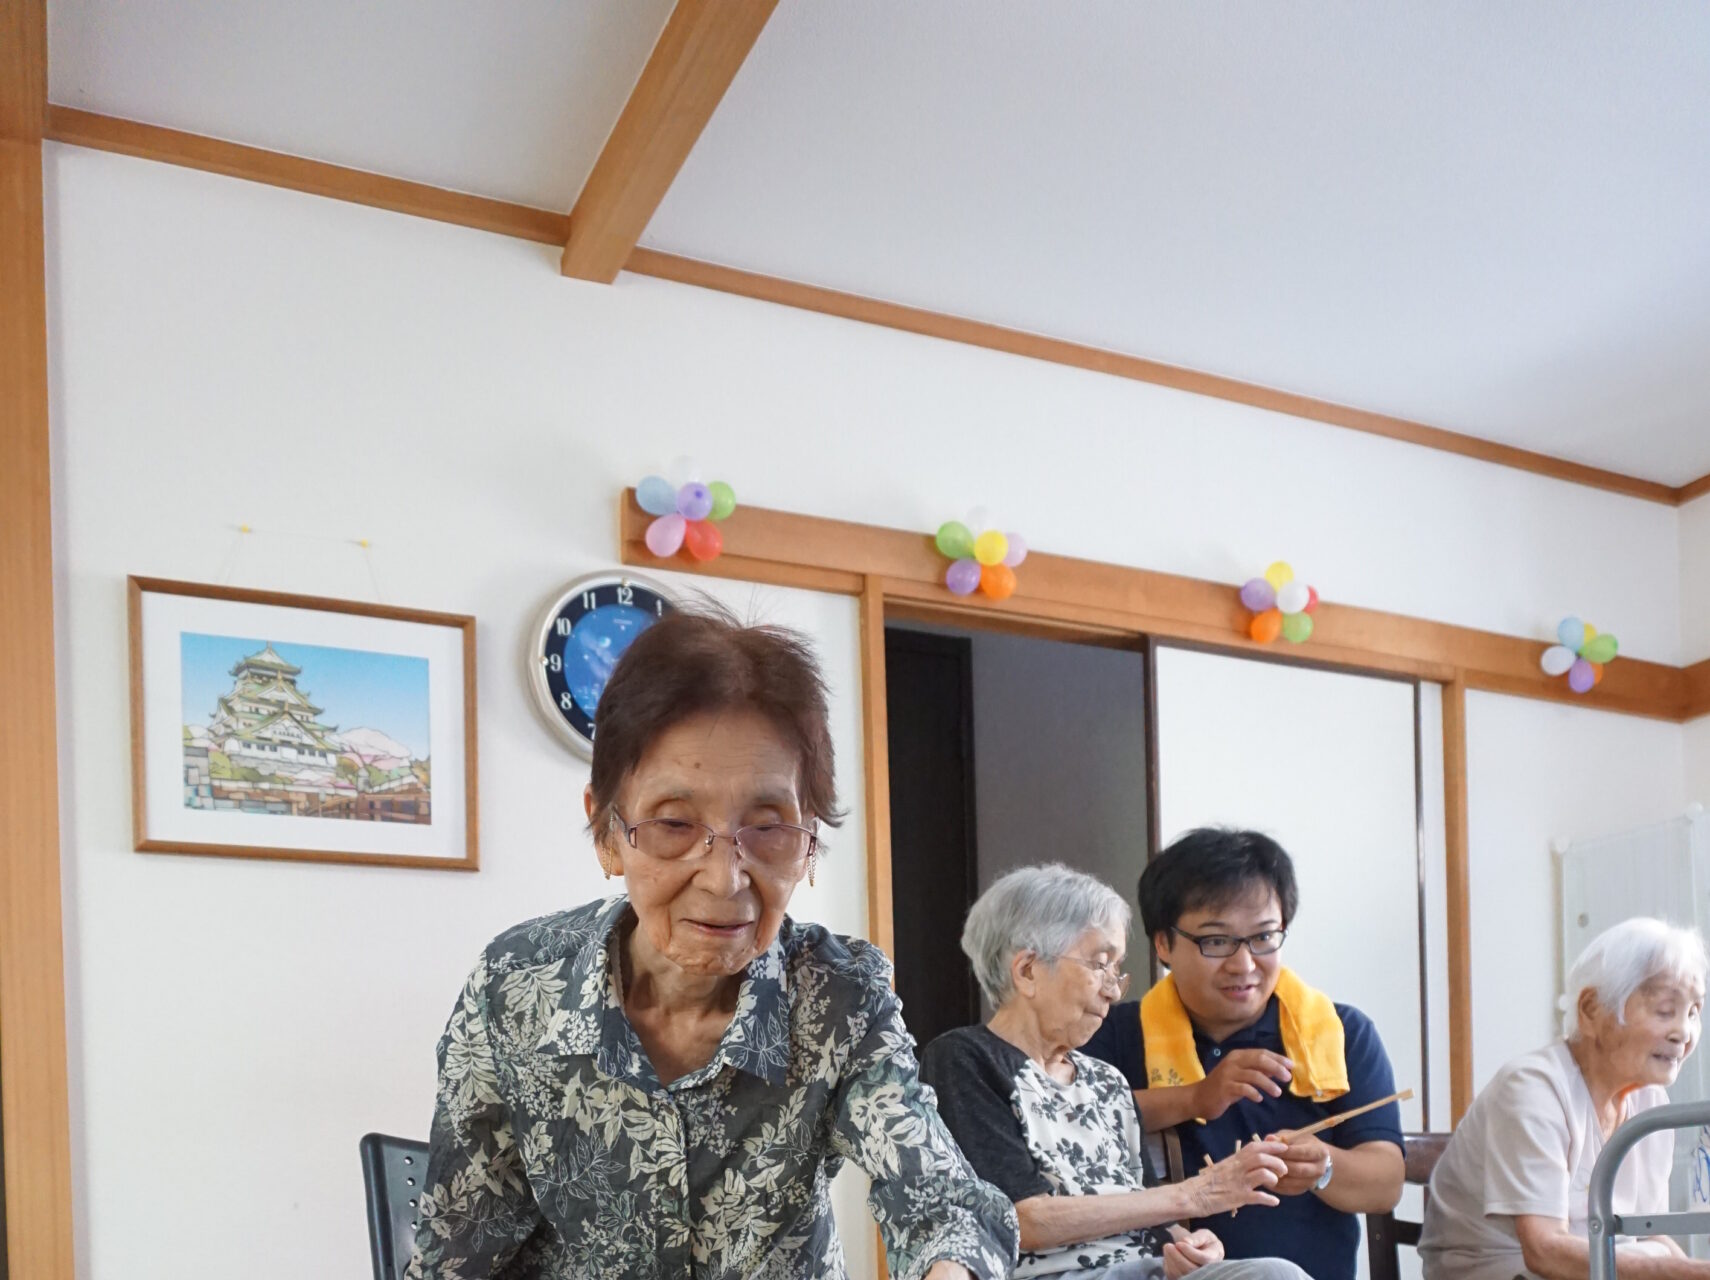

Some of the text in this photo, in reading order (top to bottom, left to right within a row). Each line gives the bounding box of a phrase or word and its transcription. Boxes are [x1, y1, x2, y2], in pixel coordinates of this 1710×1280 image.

[583, 591, 596, 610] 11
[617, 586, 633, 606] 12
[556, 617, 571, 636] 10
[550, 653, 562, 672] 9
[561, 692, 573, 710] 8
[587, 722, 597, 741] 7
